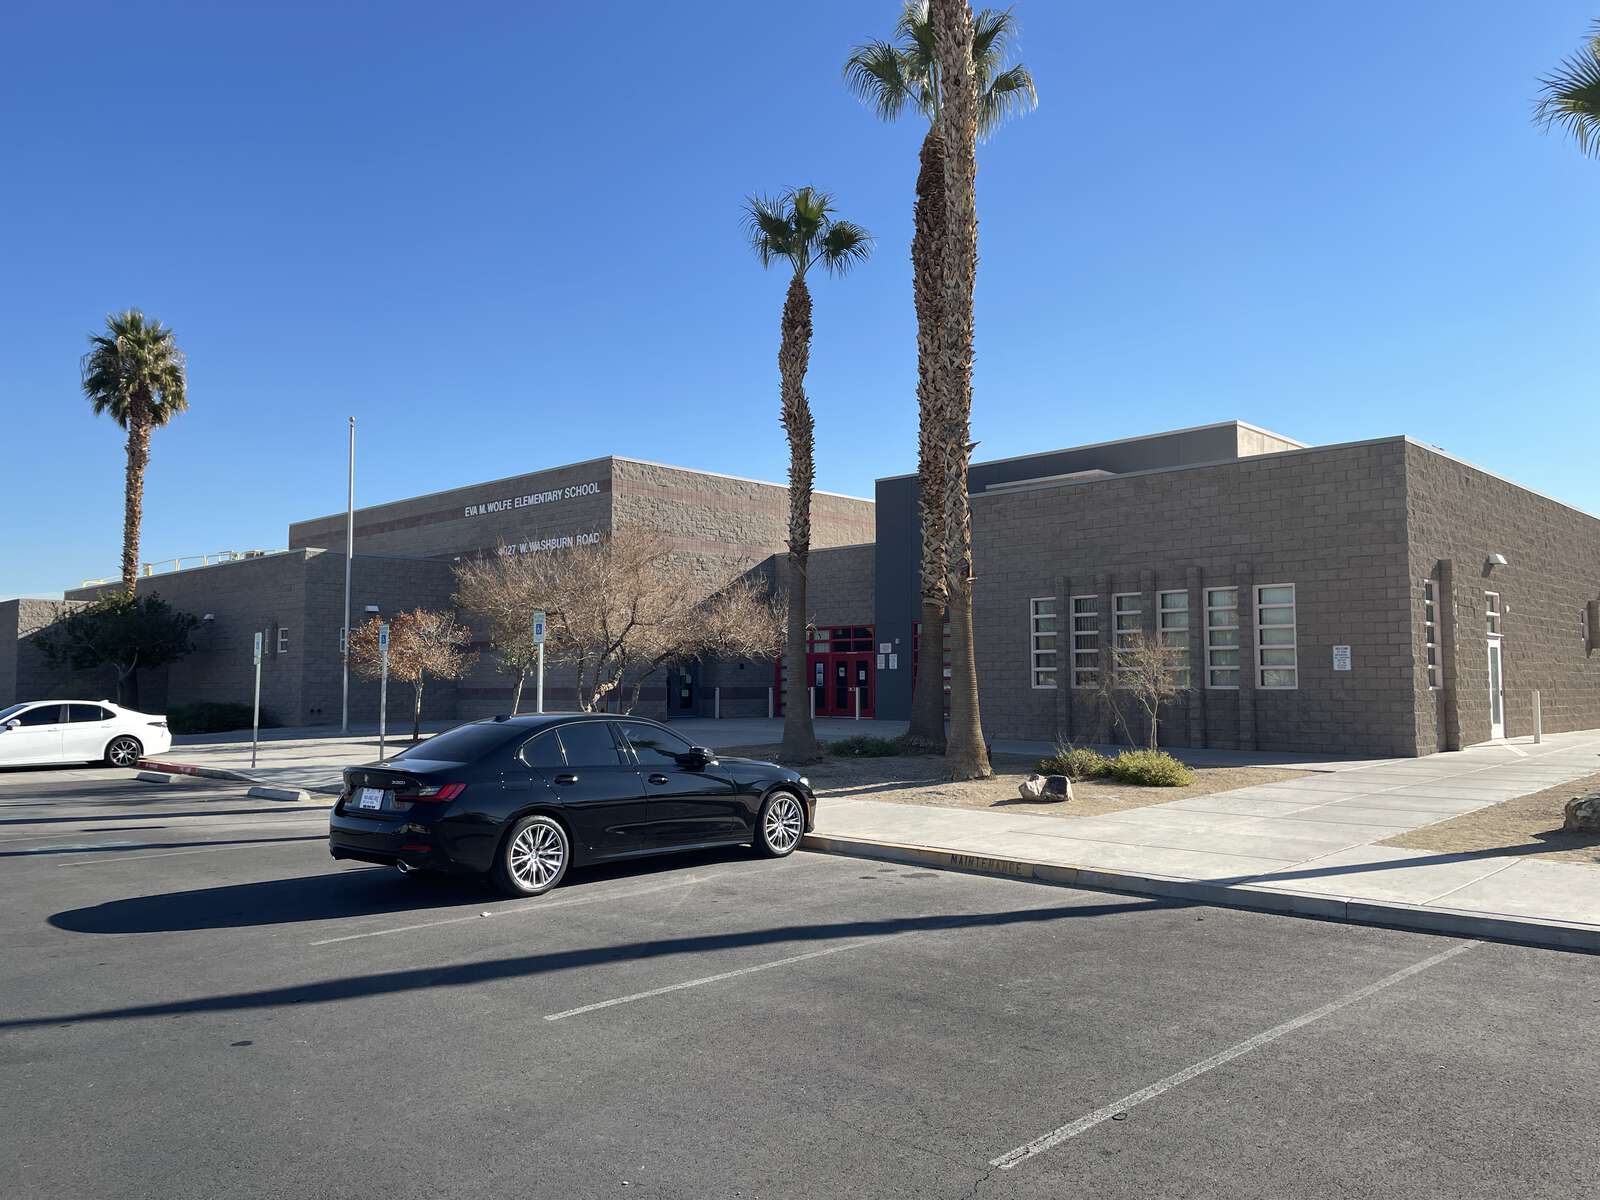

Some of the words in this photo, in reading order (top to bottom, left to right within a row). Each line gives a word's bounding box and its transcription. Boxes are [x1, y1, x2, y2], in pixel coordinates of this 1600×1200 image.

[464, 505, 478, 517] EVA
[487, 499, 512, 513] WOLFE
[514, 489, 563, 508] ELEMENTARY
[564, 482, 600, 499] SCHOOL
[529, 537, 573, 552] WASHBURN
[576, 532, 600, 545] ROAD
